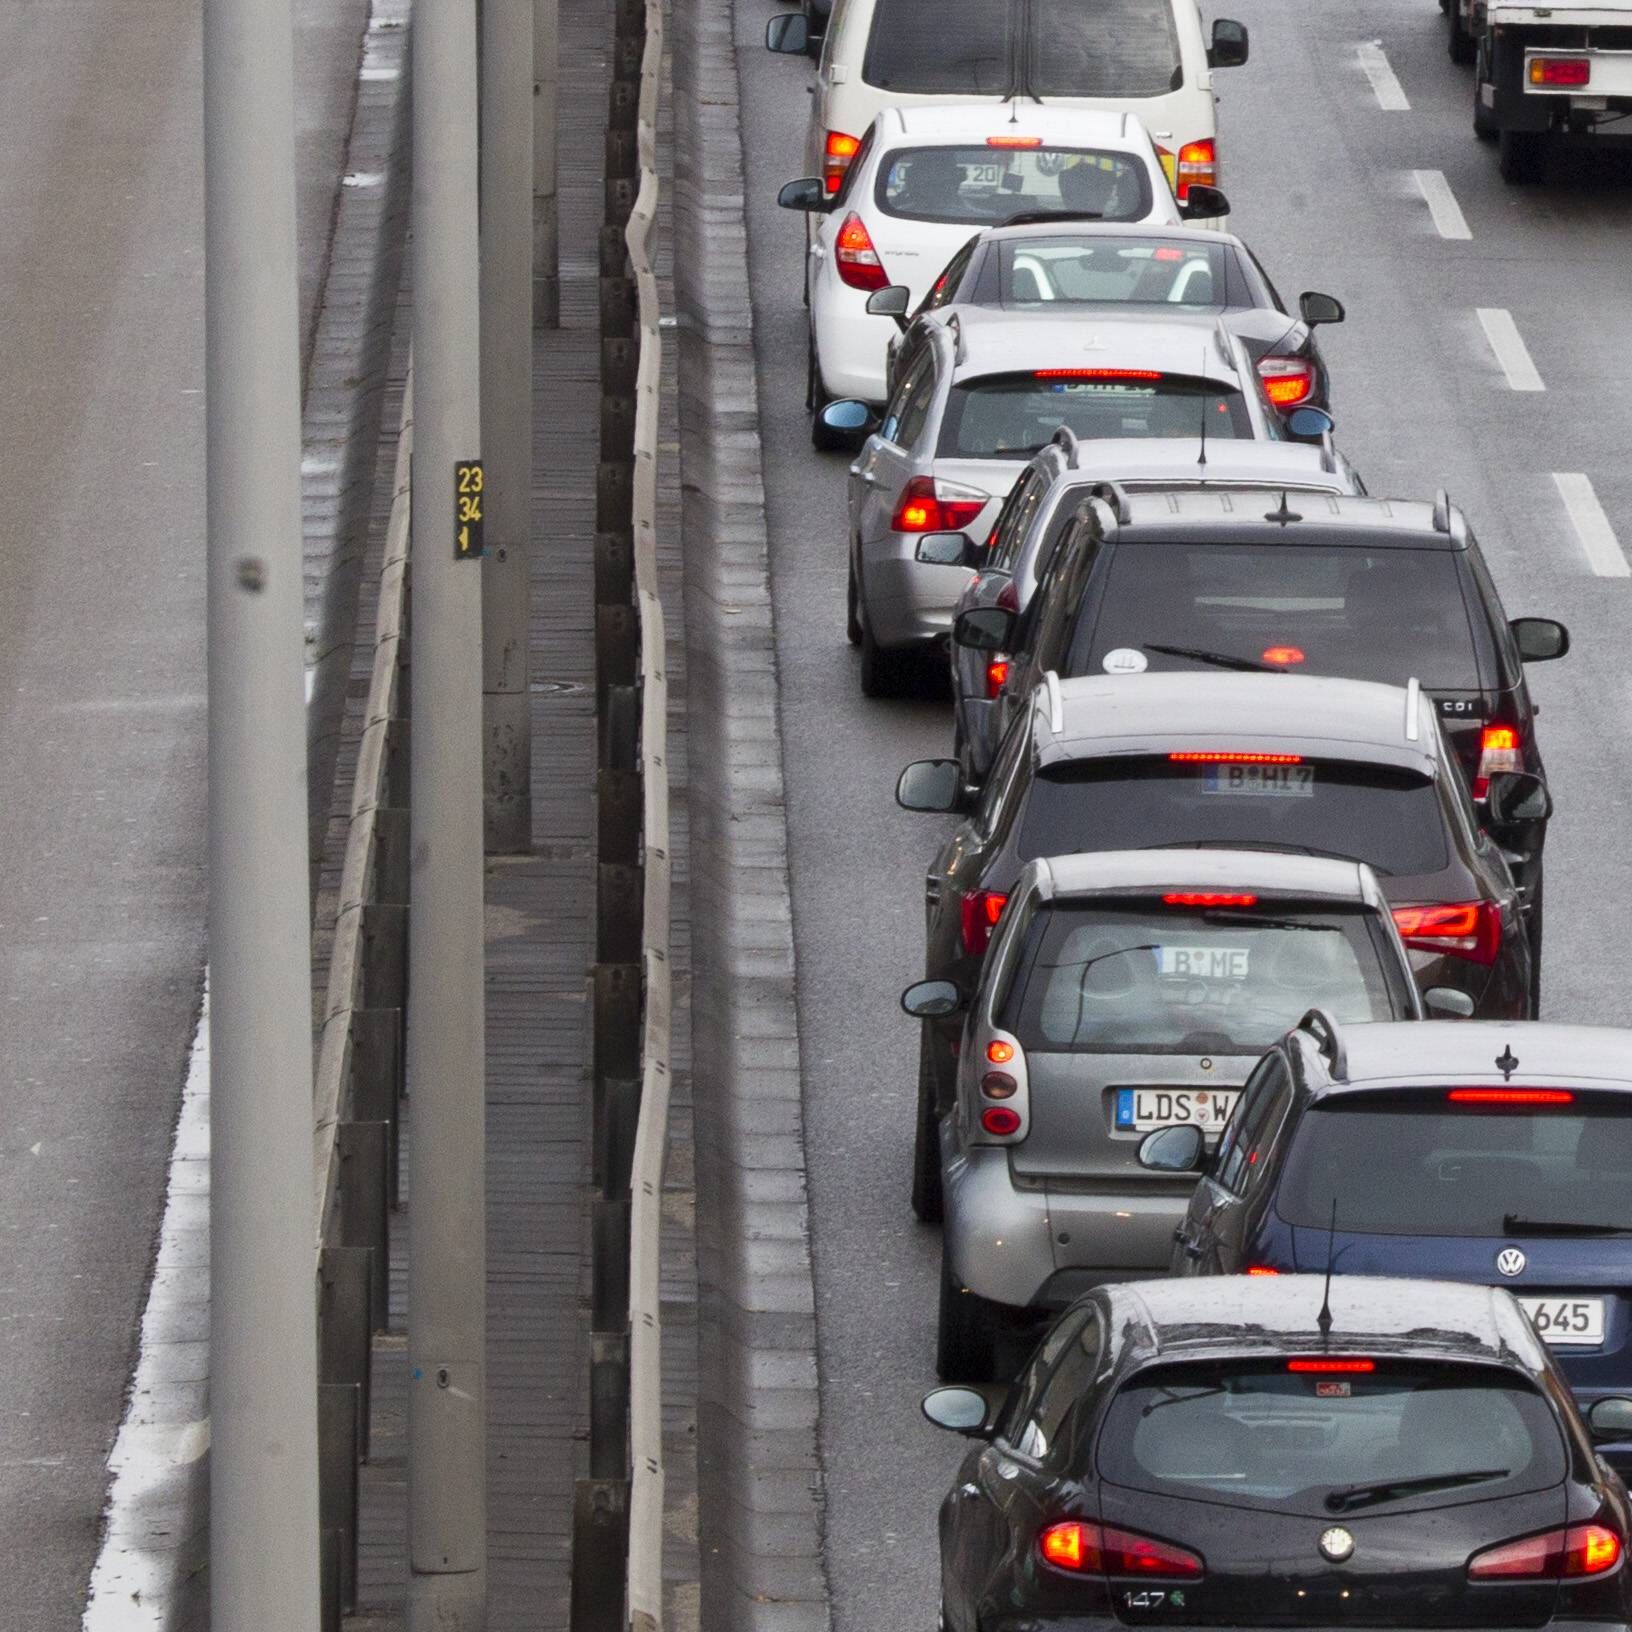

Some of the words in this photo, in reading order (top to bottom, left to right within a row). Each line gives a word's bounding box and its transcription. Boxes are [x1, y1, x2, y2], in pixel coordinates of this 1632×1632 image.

[459, 466, 483, 493] 23
[459, 497, 482, 522] 34
[1229, 766, 1244, 788] B
[1176, 951, 1191, 973] B
[1136, 1094, 1192, 1122] LDS
[1212, 1094, 1229, 1122] W
[1534, 1302, 1590, 1334] 645
[1123, 1591, 1166, 1608] 147
